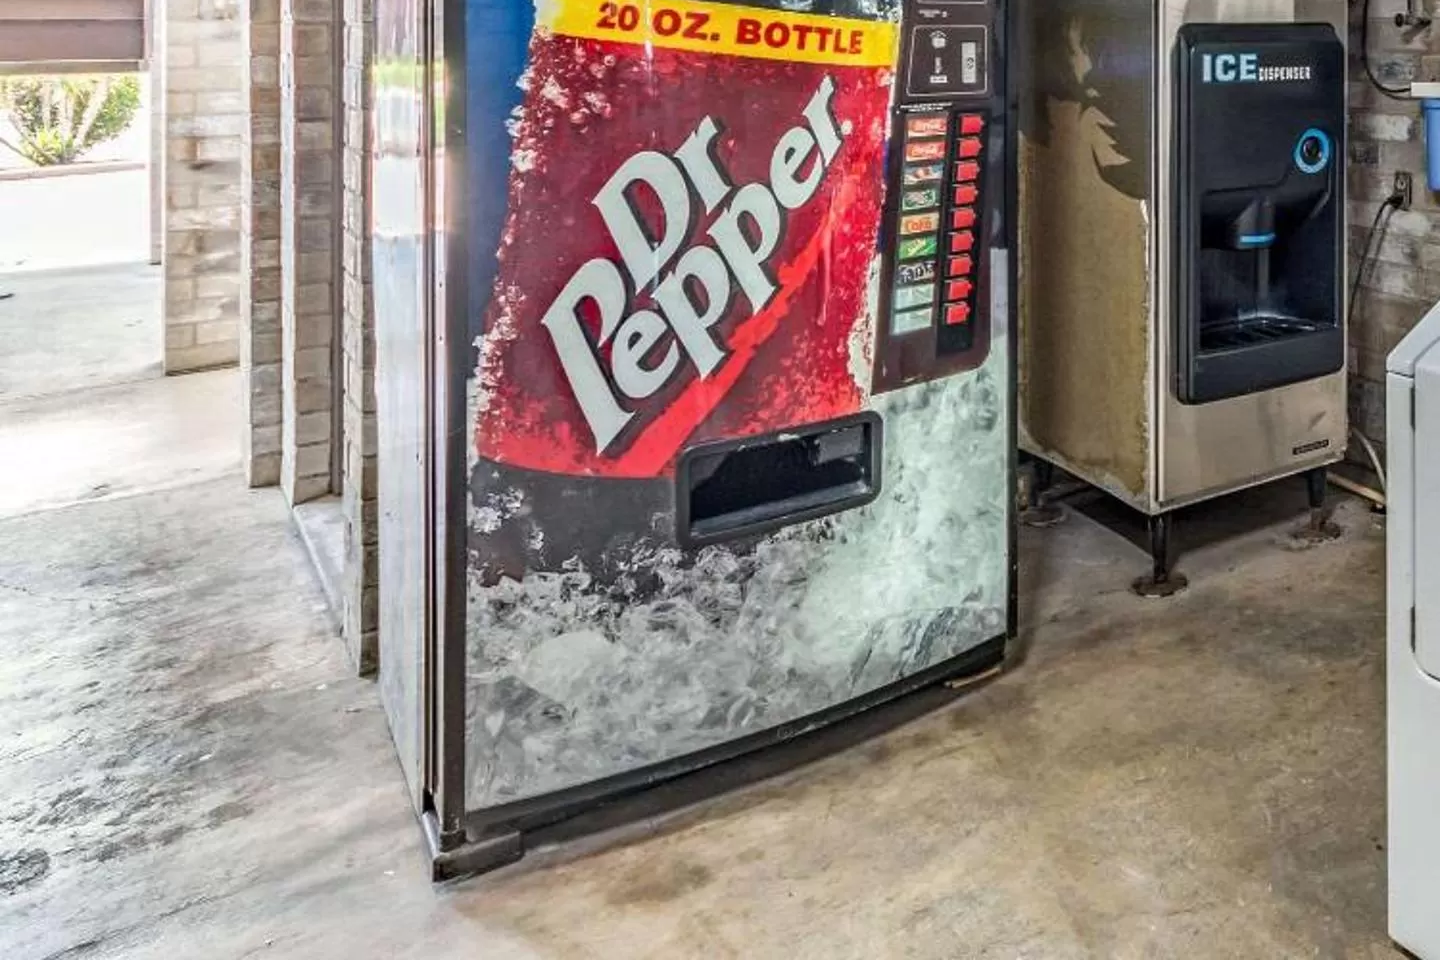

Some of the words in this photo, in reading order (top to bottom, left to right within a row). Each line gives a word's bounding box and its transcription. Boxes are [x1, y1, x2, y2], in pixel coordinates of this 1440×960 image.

[596, 1, 639, 32] 20
[653, 7, 720, 42] OZ.
[736, 19, 864, 55] BOTTLE
[1202, 53, 1258, 82] ICE
[1259, 66, 1311, 82] DISPENSER
[592, 115, 732, 295] Dr
[541, 74, 843, 456] Pepper
